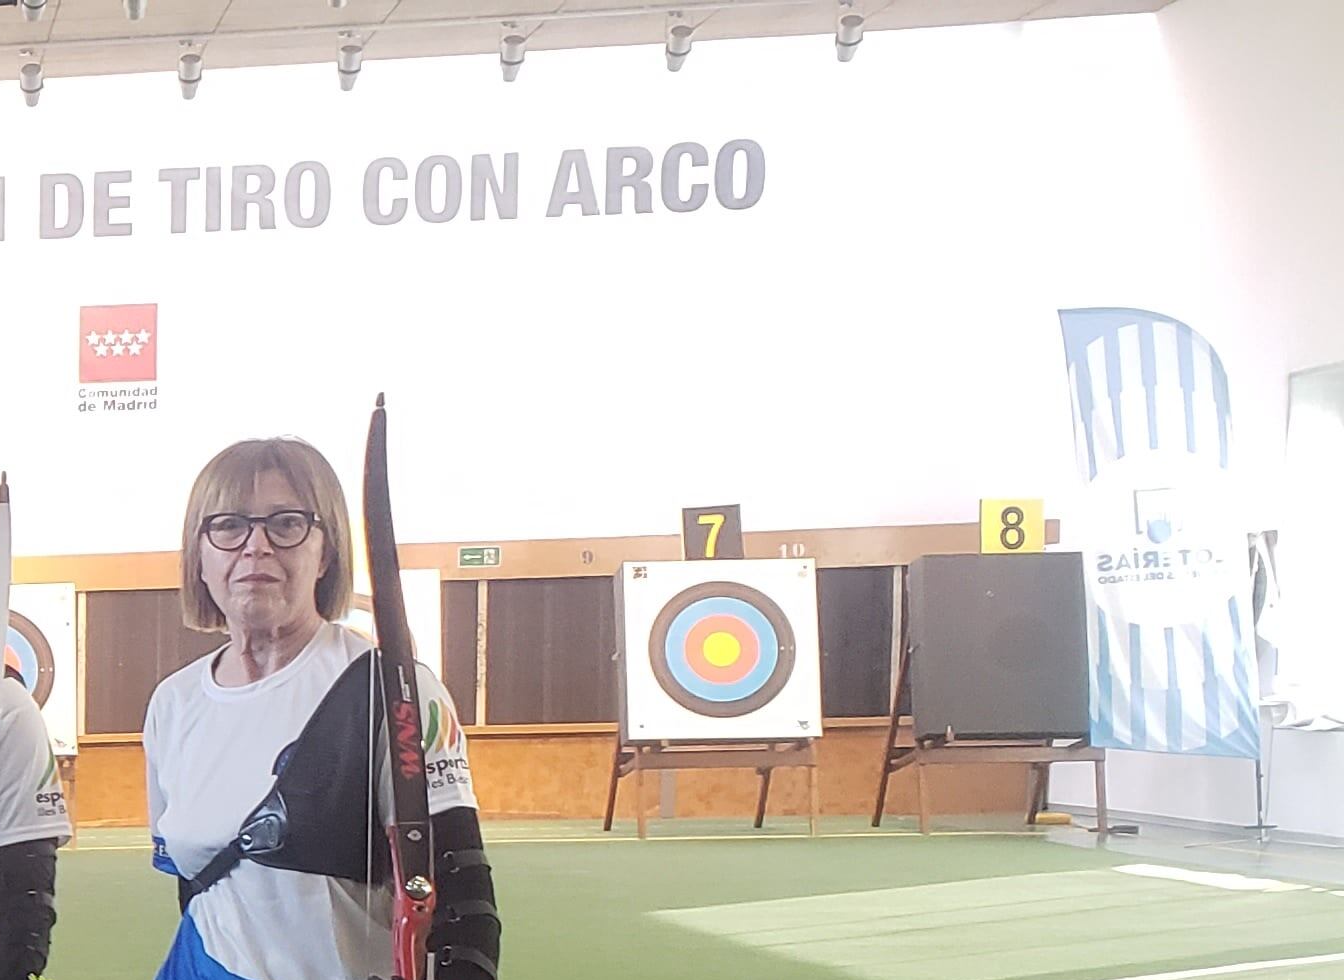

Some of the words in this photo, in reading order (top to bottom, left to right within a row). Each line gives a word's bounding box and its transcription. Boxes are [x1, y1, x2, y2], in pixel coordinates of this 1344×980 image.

[39, 170, 133, 239] DE
[159, 160, 332, 233] TIRO
[362, 152, 519, 226] CON
[546, 138, 766, 217] ARCO
[78, 386, 158, 399] Comunidad
[78, 401, 97, 412] de
[103, 399, 158, 411] Madrid
[696, 513, 727, 559] 7
[1000, 506, 1025, 550] 8
[582, 550, 594, 565] 9
[779, 543, 805, 559] 10
